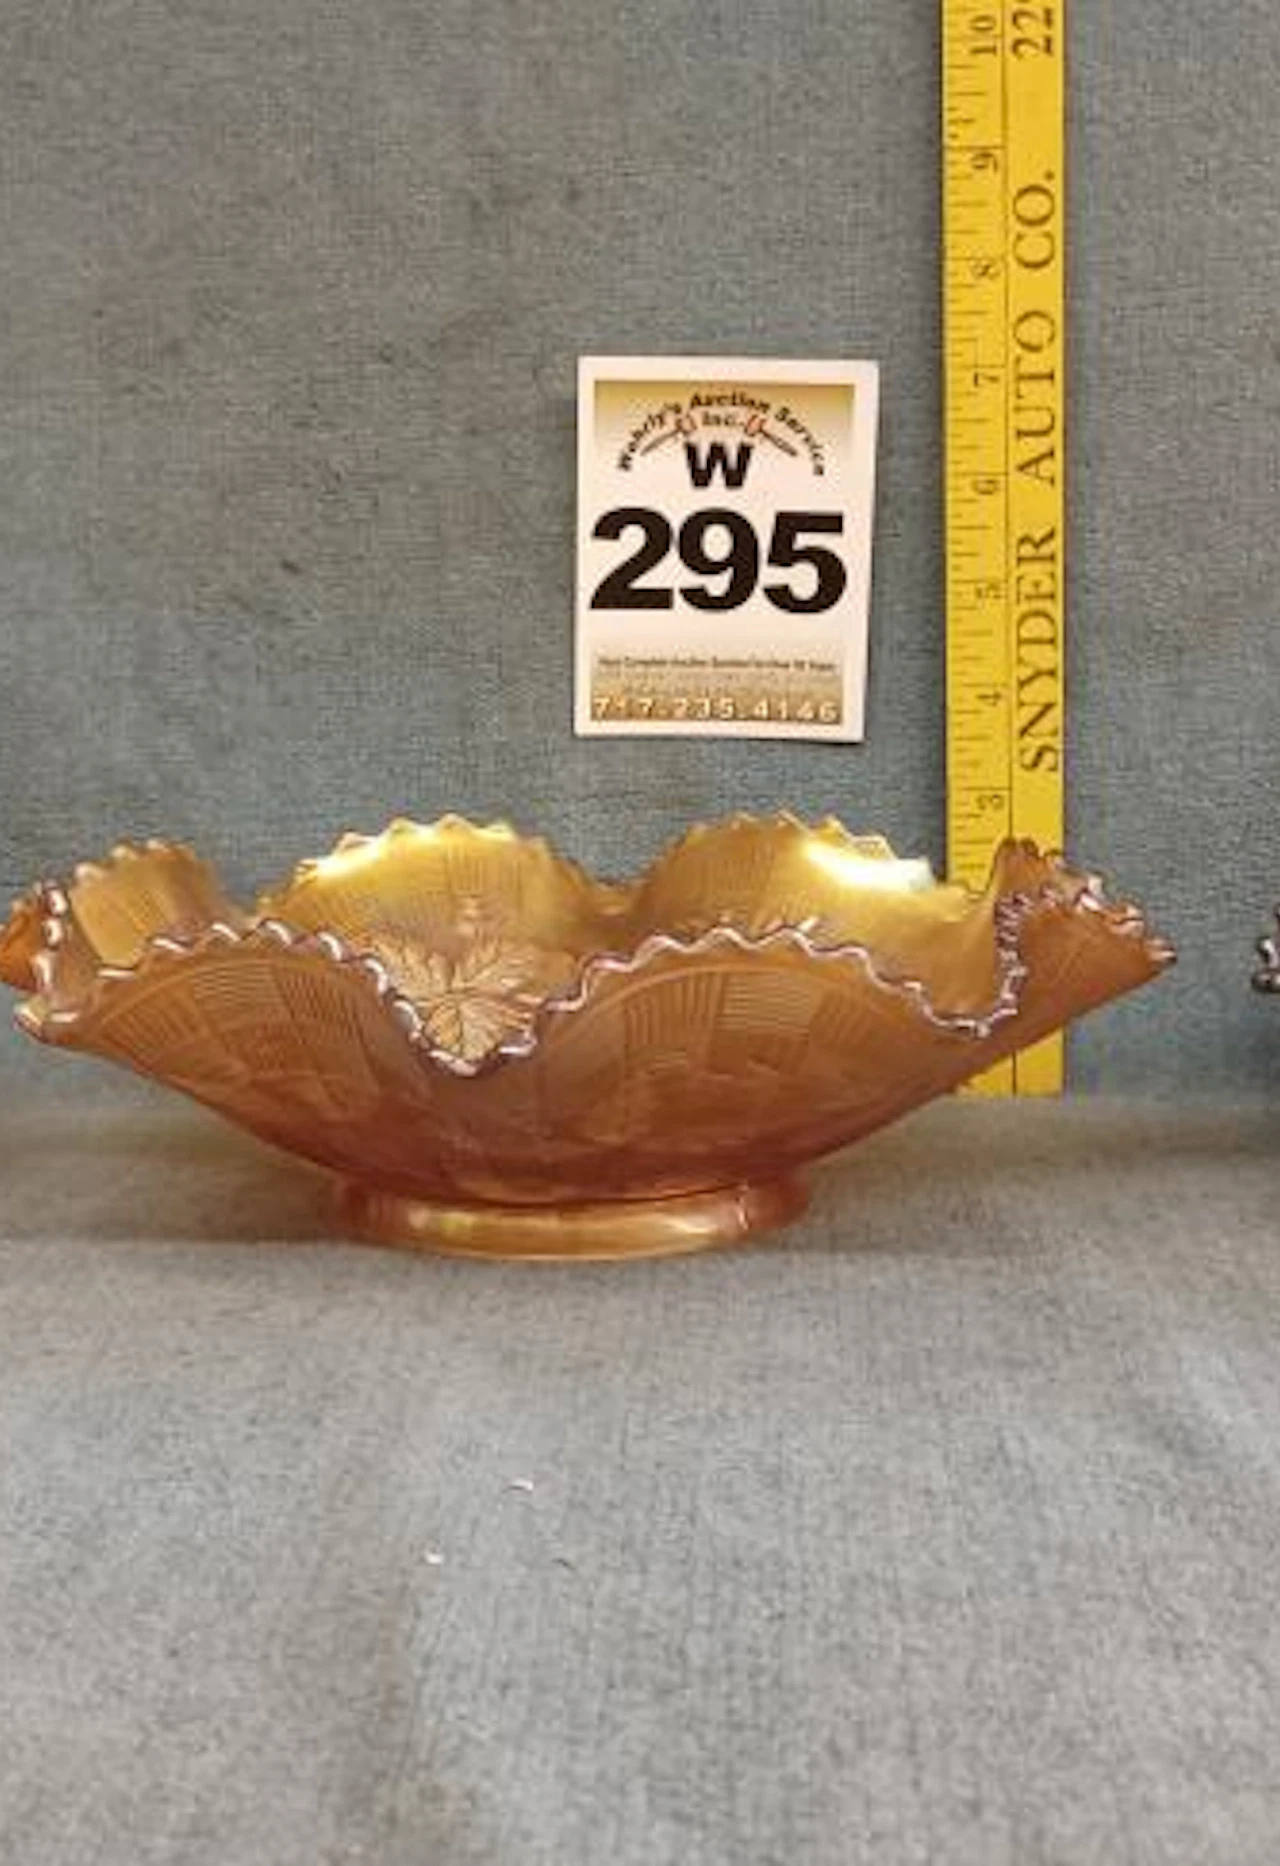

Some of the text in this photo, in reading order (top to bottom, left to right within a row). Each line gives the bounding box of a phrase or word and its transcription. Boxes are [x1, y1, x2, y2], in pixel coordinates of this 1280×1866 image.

[969, 14, 998, 57] 10
[1011, 0, 1055, 59] 22
[971, 151, 998, 173] 9
[971, 259, 1000, 279] 8
[973, 372, 1001, 388] 7
[701, 410, 745, 427] Inc.
[689, 391, 771, 414] Auction
[773, 406, 825, 476] Service
[683, 441, 754, 489] W
[1012, 169, 1060, 772] SNYDER AUTO CO.
[972, 478, 1001, 496] 6
[590, 507, 847, 613] 295
[974, 582, 1005, 602] 5
[975, 690, 1003, 707] 4
[975, 793, 1005, 812] 3
